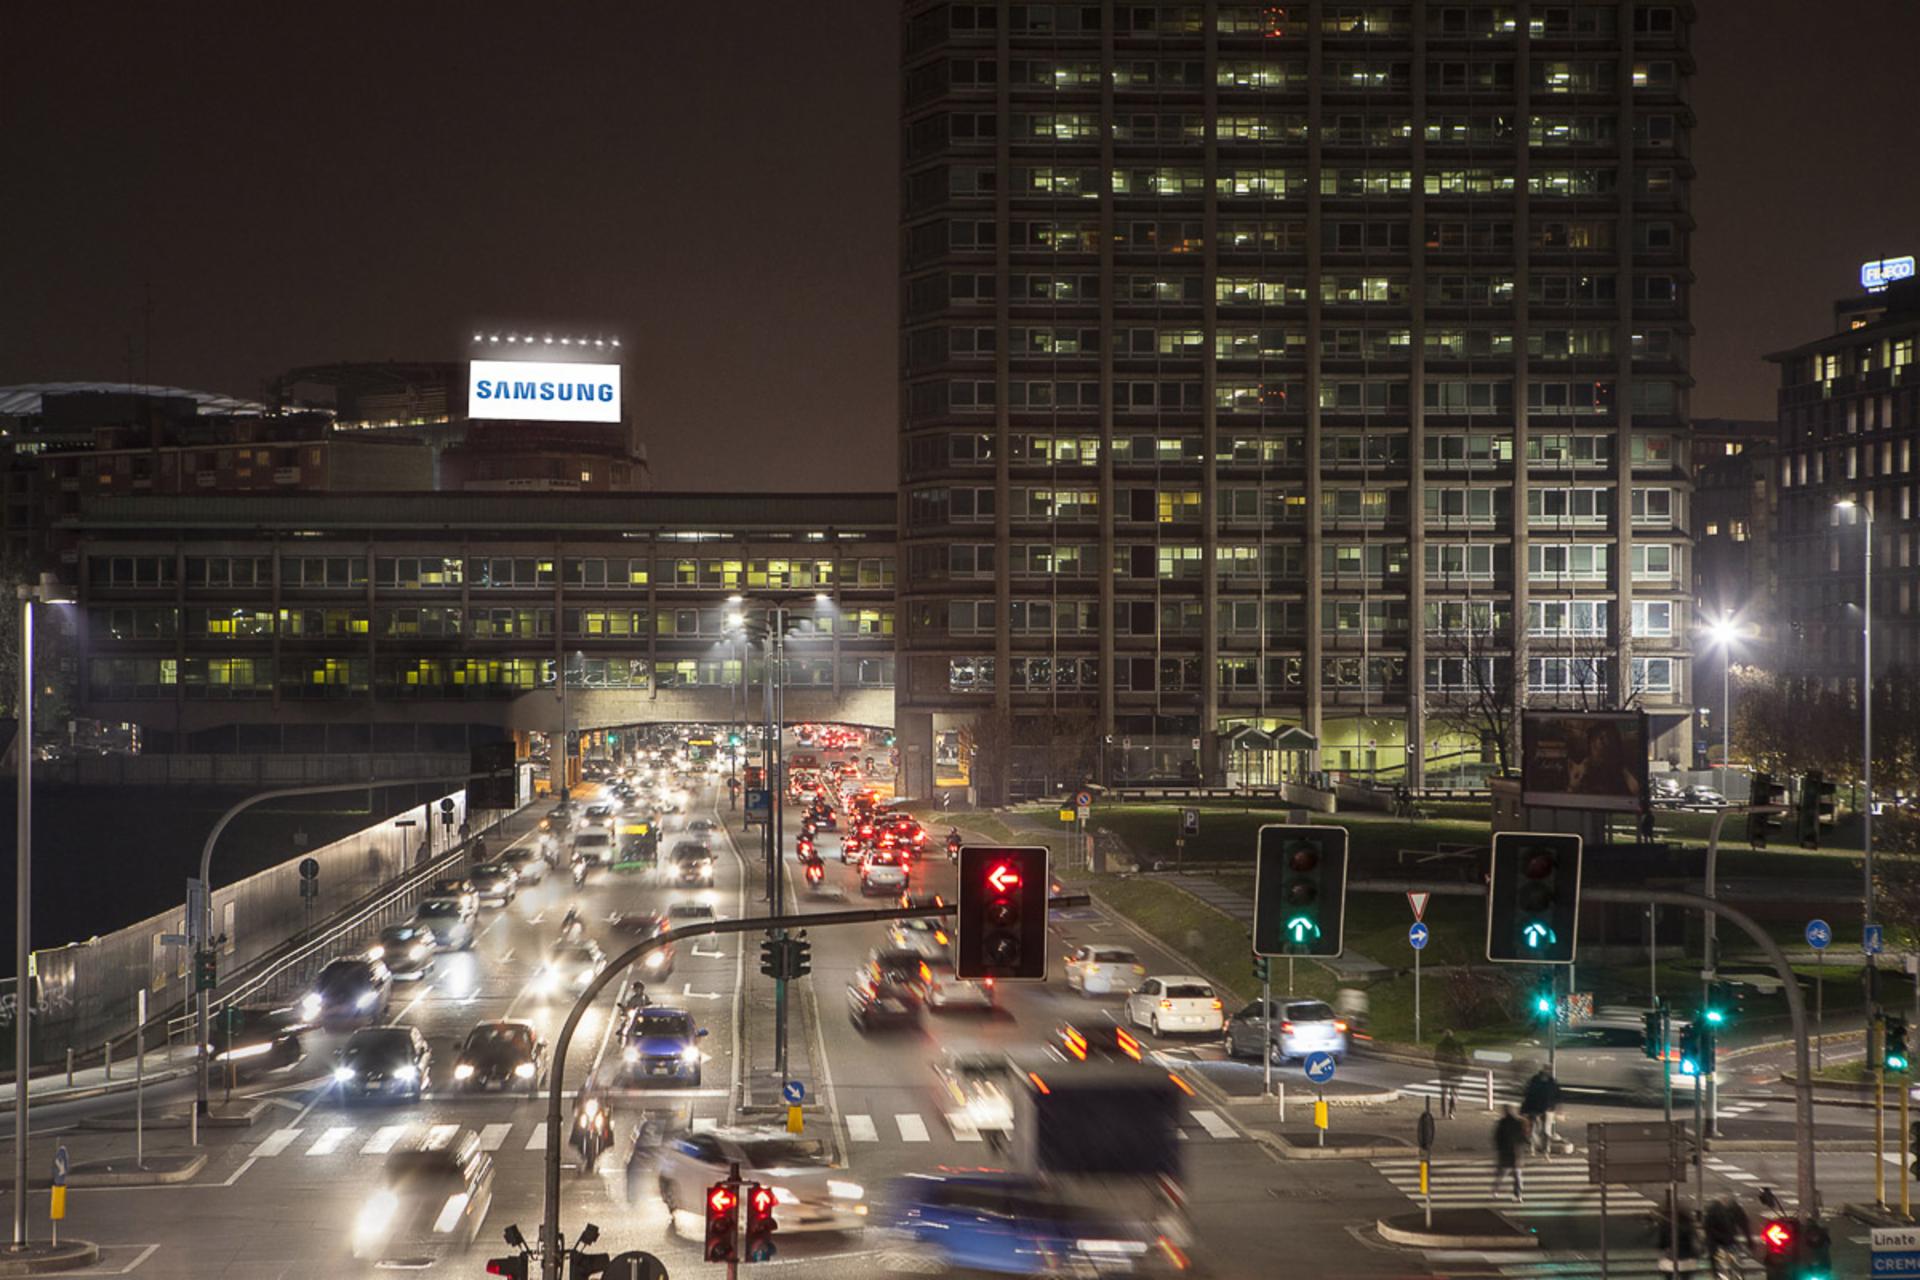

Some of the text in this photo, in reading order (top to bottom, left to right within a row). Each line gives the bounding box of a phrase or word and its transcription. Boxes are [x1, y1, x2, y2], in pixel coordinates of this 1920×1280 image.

[476, 379, 614, 402] SAMSUNG
[747, 792, 761, 808] P
[1186, 811, 1196, 827] P
[1874, 1234, 1916, 1246] Linate
